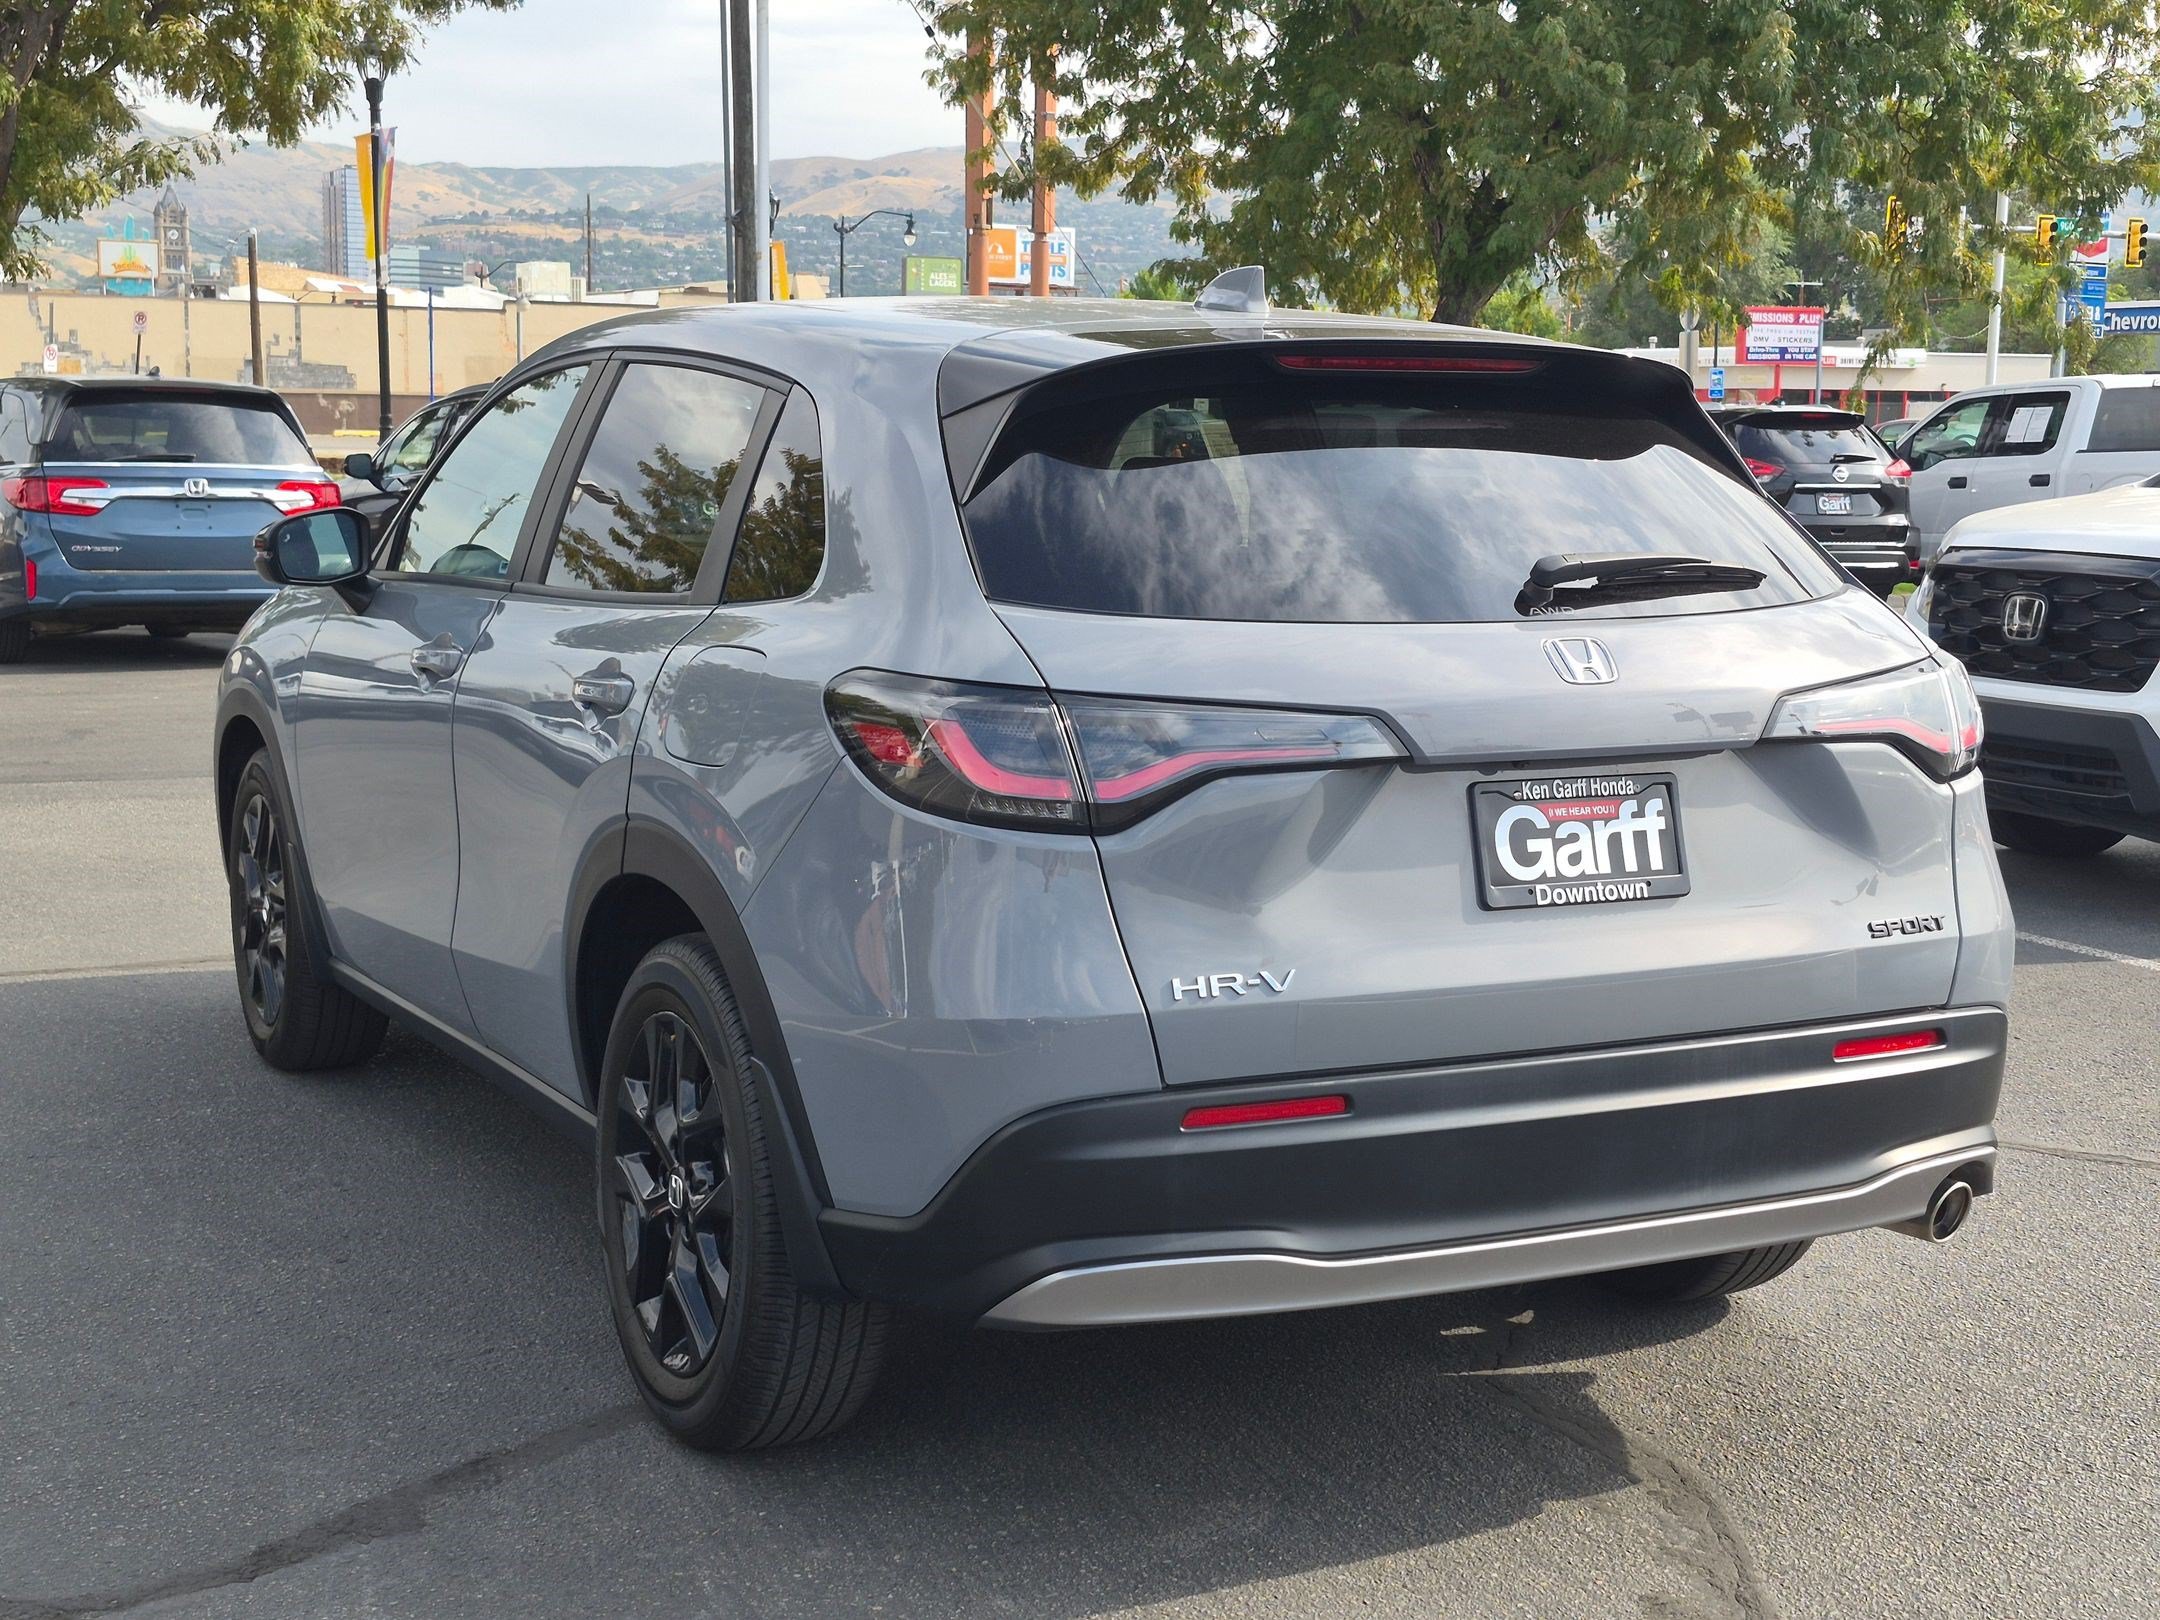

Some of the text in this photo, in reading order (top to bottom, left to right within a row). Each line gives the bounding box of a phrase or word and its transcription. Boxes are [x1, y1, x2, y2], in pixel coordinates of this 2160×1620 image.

[929, 279, 957, 288] LAGERS
[1799, 313, 1821, 324] PLUS
[2103, 312, 2160, 331] Chevro
[1778, 336, 1813, 344] STICKERS
[1822, 356, 1836, 365] LUS
[1819, 496, 1850, 511] Garff
[1529, 606, 1575, 616] AWD
[1522, 777, 1634, 800] Ken Garff Honda
[1555, 806, 1609, 816] WE HEAR YOU
[1495, 798, 1666, 881] Garff
[1535, 882, 1648, 906] Downtown
[1867, 915, 1945, 939] SPORT
[1171, 969, 1296, 1001] HR-V
